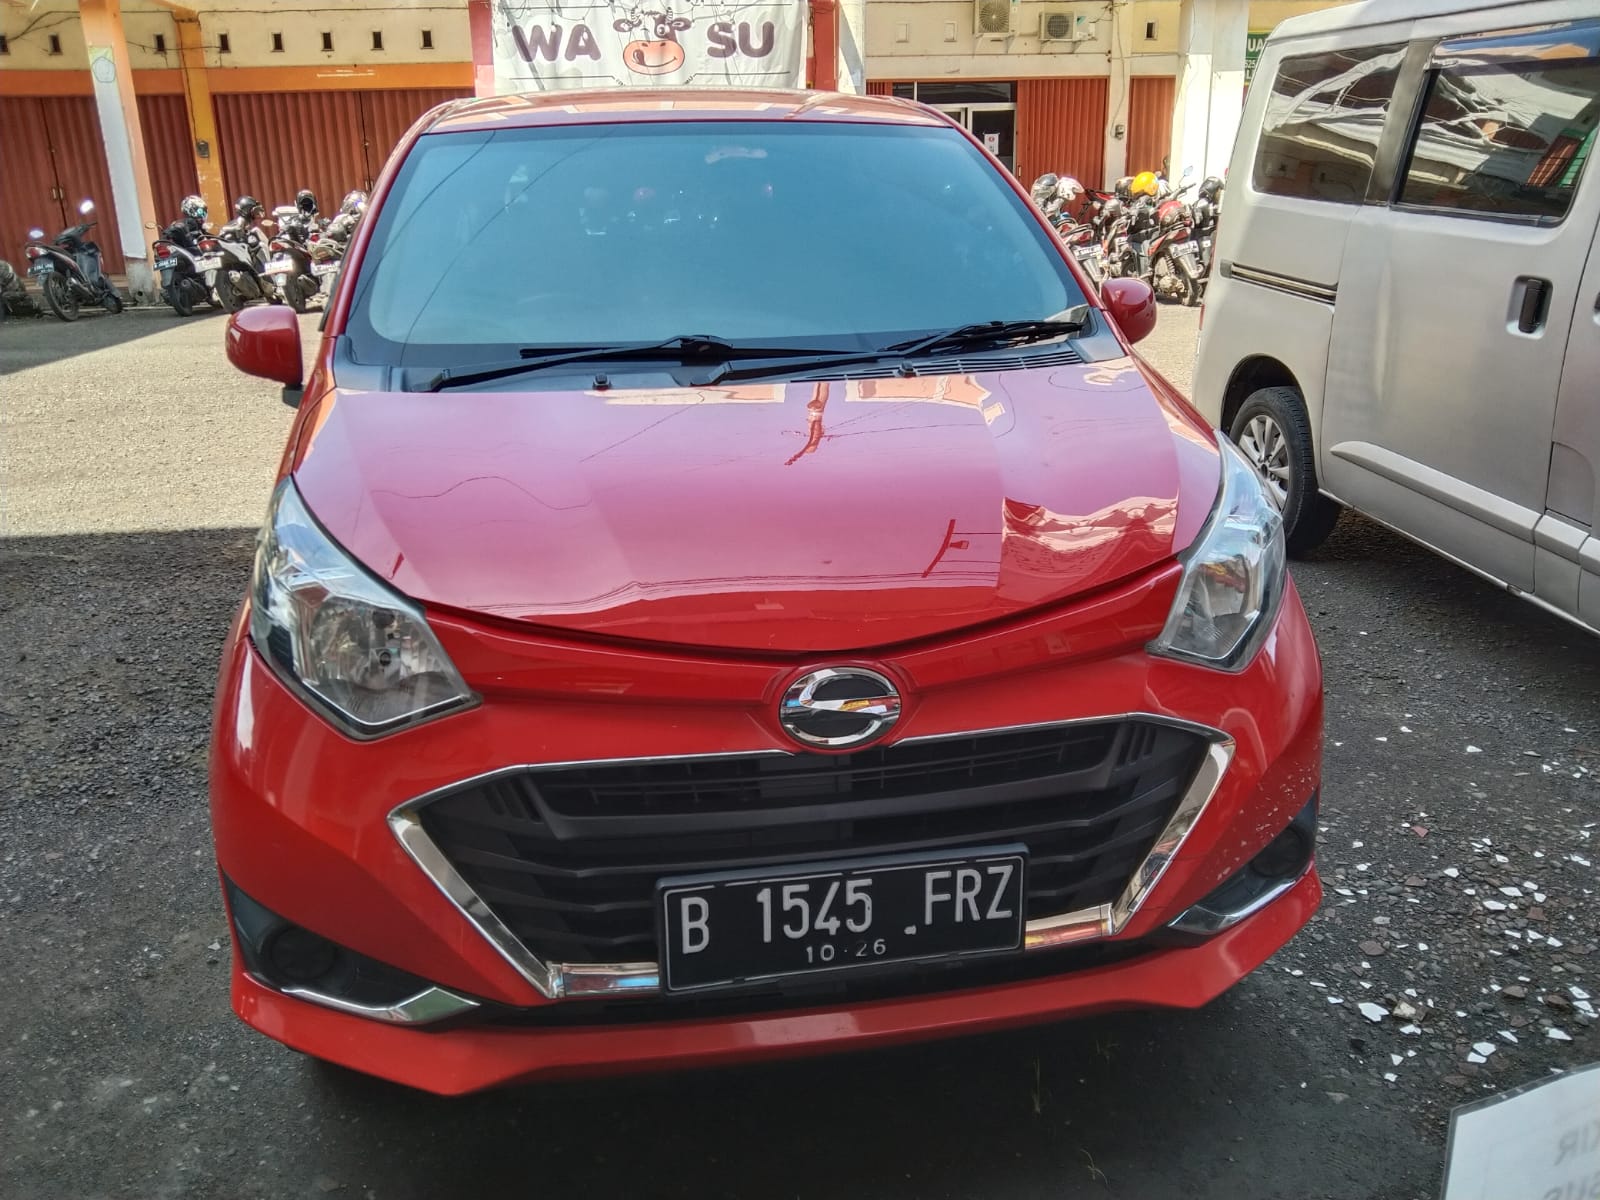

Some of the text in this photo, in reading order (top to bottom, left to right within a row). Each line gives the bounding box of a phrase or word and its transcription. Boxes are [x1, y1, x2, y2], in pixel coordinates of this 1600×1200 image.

[511, 20, 775, 62] WA SU
[680, 864, 1015, 955] B 1545 FRZ
